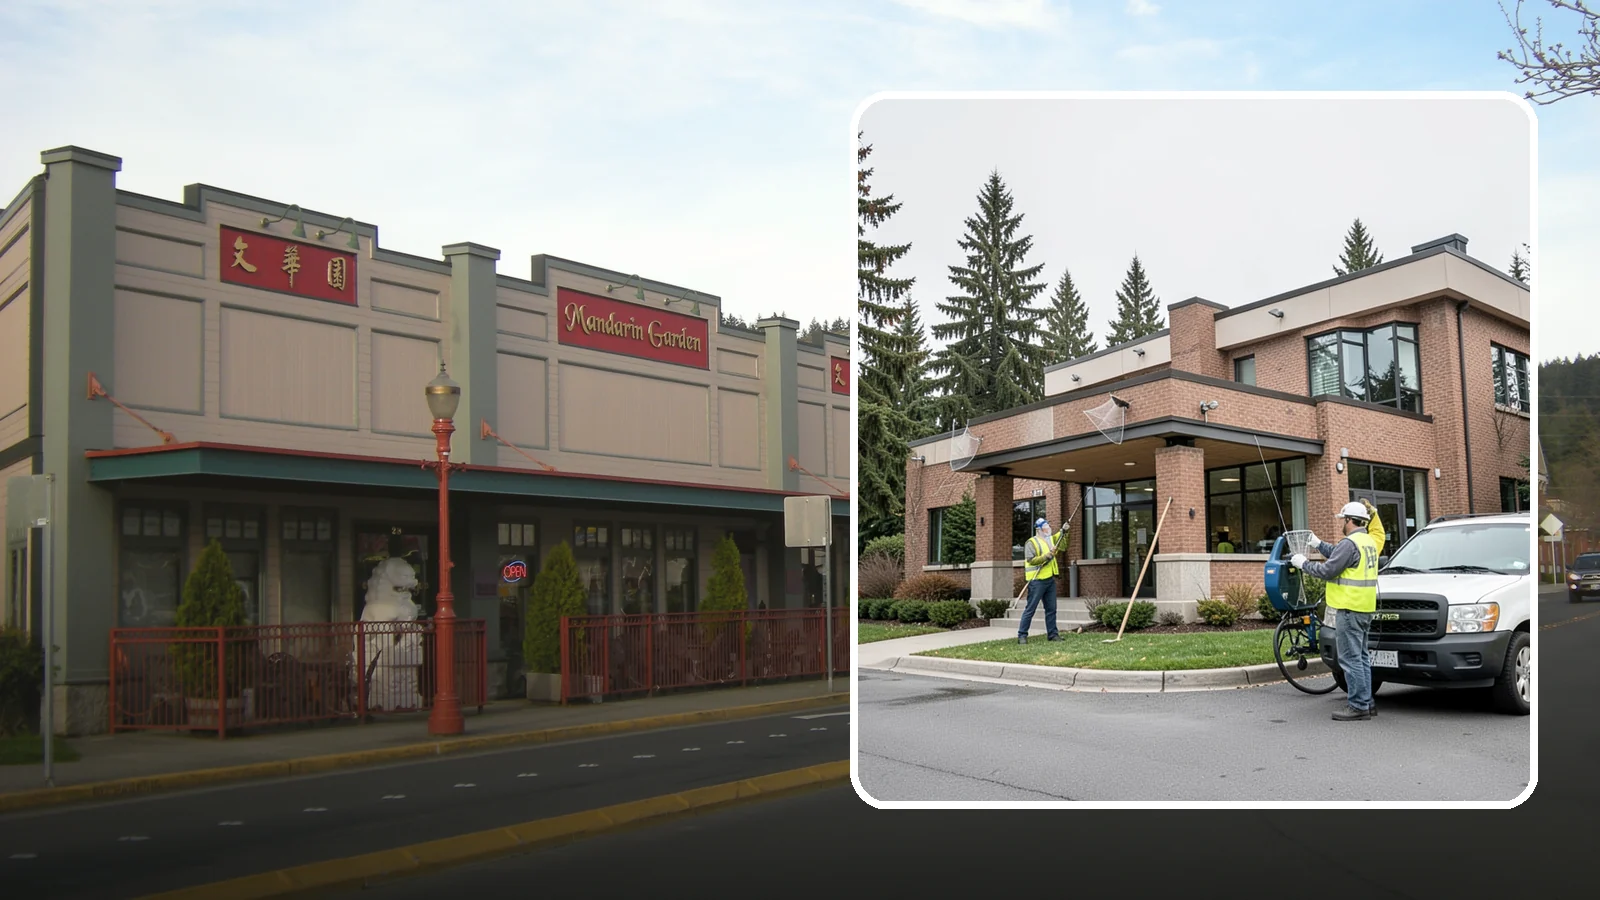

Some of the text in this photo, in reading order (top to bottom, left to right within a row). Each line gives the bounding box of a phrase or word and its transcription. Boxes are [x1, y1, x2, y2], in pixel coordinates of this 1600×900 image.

[230, 235, 347, 291] 文華園
[564, 302, 702, 352] Mandarin Garden
[834, 363, 847, 386] 文
[503, 565, 527, 578] OPEN
